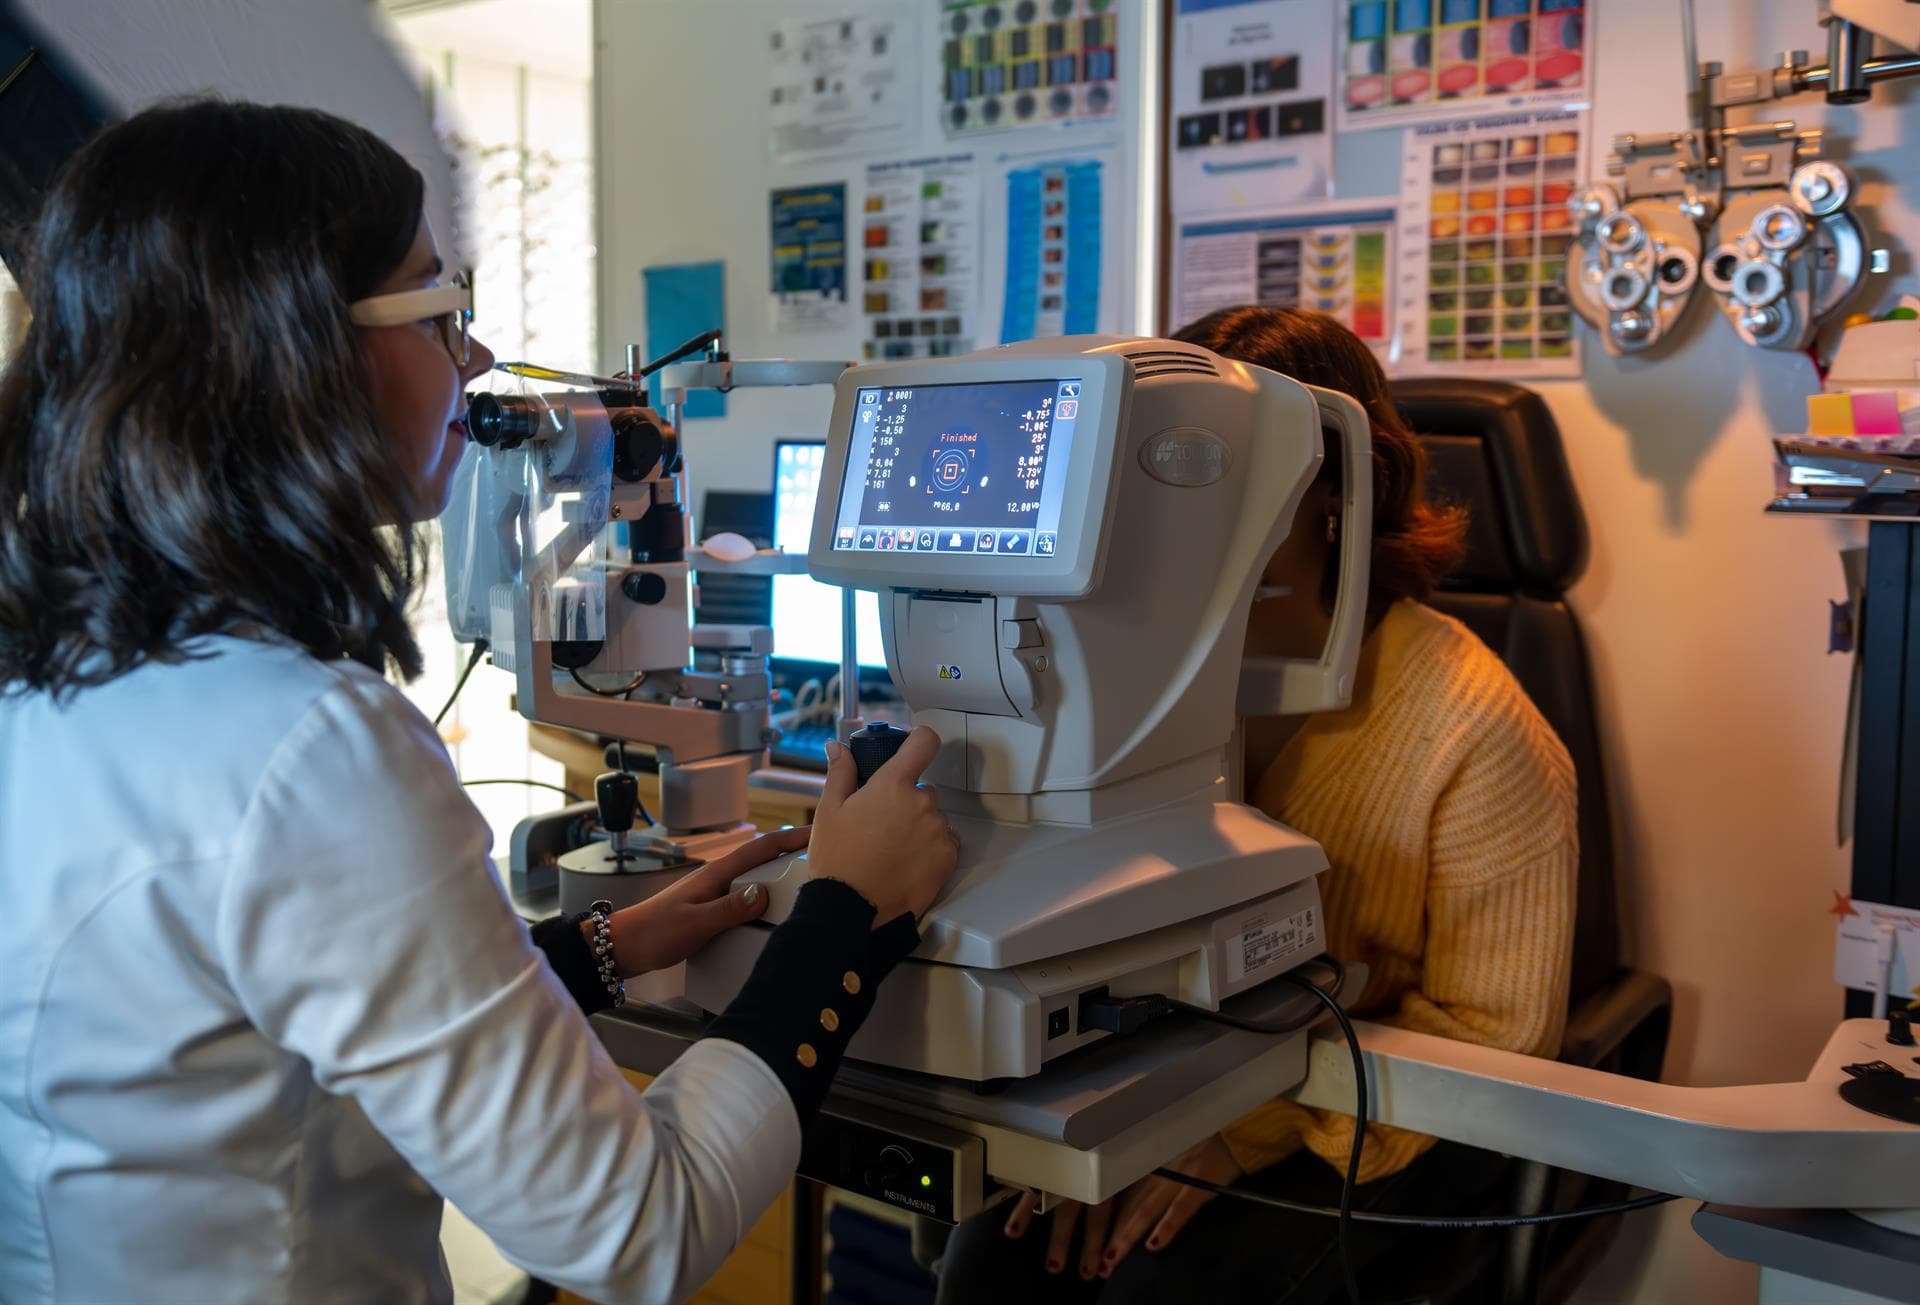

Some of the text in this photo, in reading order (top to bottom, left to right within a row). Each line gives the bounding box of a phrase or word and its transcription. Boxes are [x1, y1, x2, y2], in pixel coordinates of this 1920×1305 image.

[883, 415, 905, 424] -1.25
[881, 426, 903, 435] -0.50
[880, 437, 893, 446] 150
[940, 433, 978, 443] Finished
[884, 1188, 936, 1213] INSTRUMENTS
